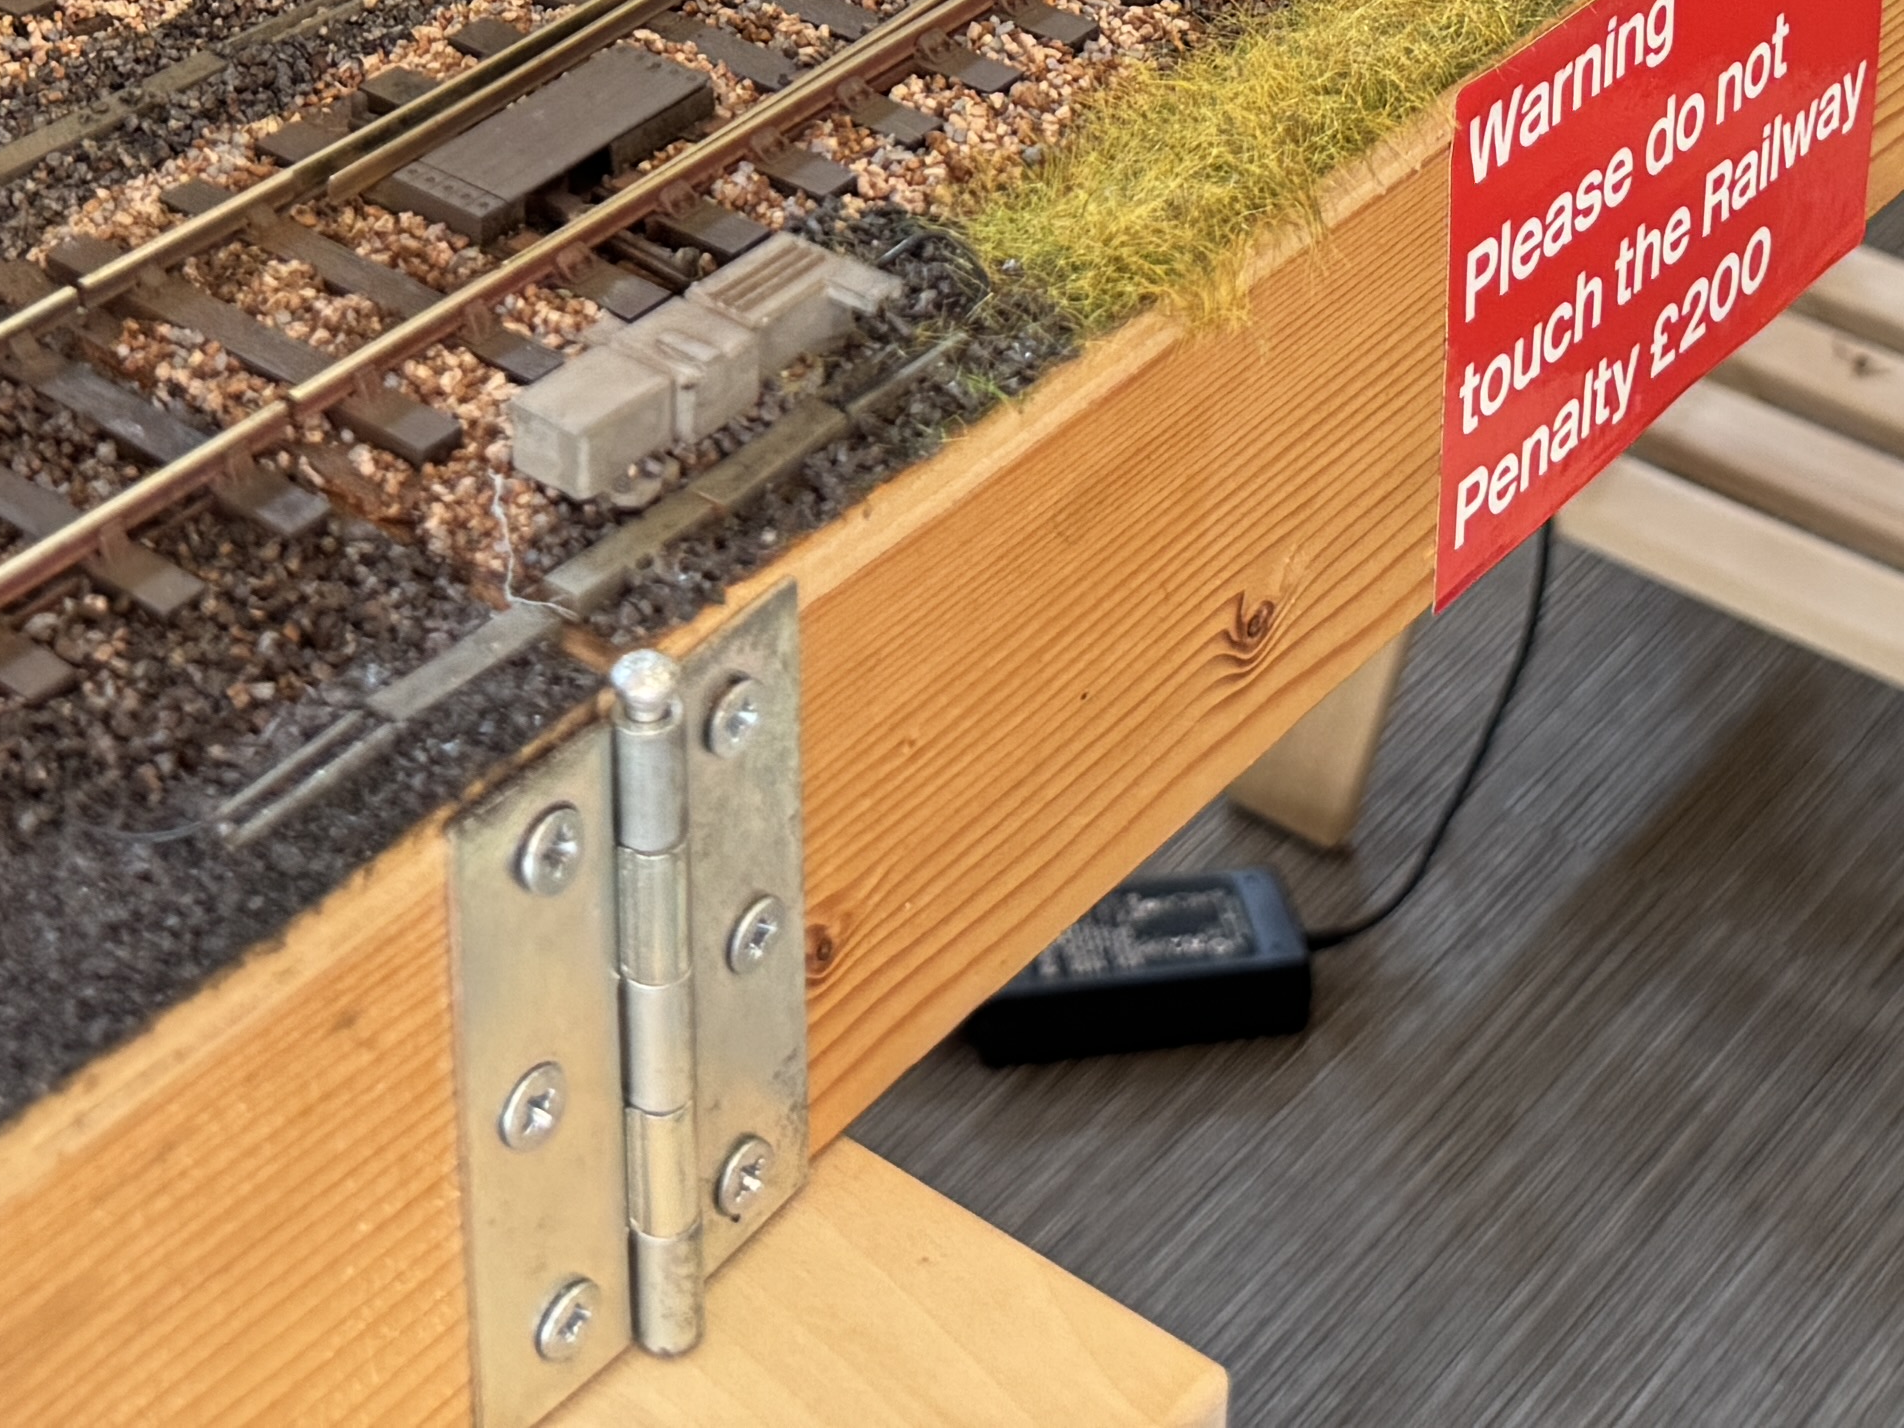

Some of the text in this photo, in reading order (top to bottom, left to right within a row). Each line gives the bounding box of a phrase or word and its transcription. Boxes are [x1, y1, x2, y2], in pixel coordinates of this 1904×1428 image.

[1460, 60, 1867, 437] touch the Railway
[1464, 12, 1790, 324] Please do not
[1453, 224, 1773, 550] Penalty £200
